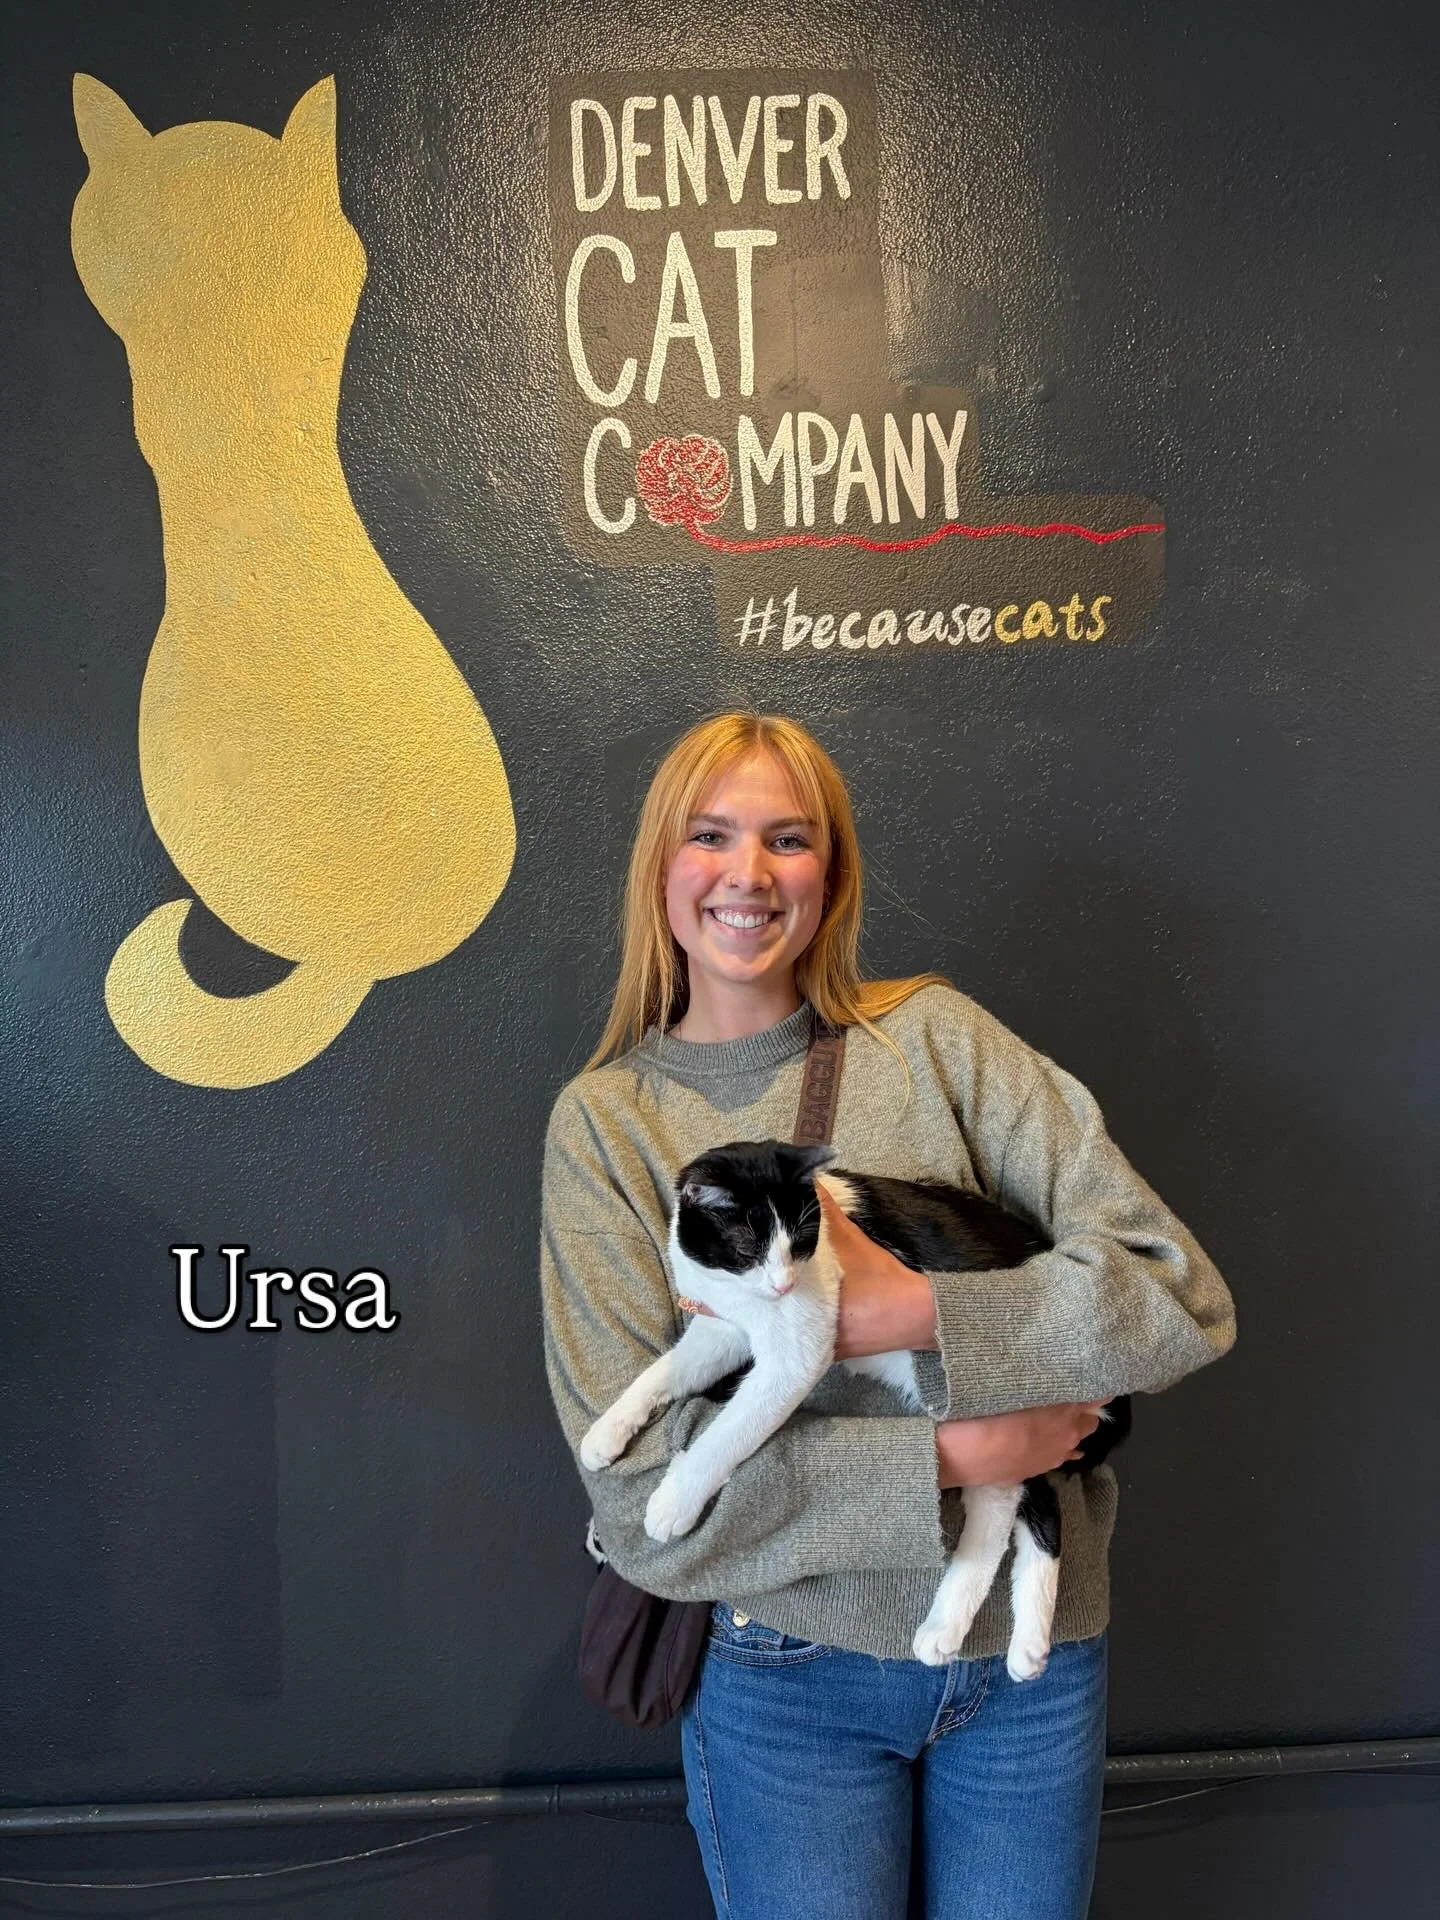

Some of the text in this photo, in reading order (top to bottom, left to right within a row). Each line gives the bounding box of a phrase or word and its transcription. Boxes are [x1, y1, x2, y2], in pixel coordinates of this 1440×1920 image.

[570, 92, 851, 213] DENVER
[564, 229, 778, 409] CAT
[733, 586, 1112, 651] #becausecats
